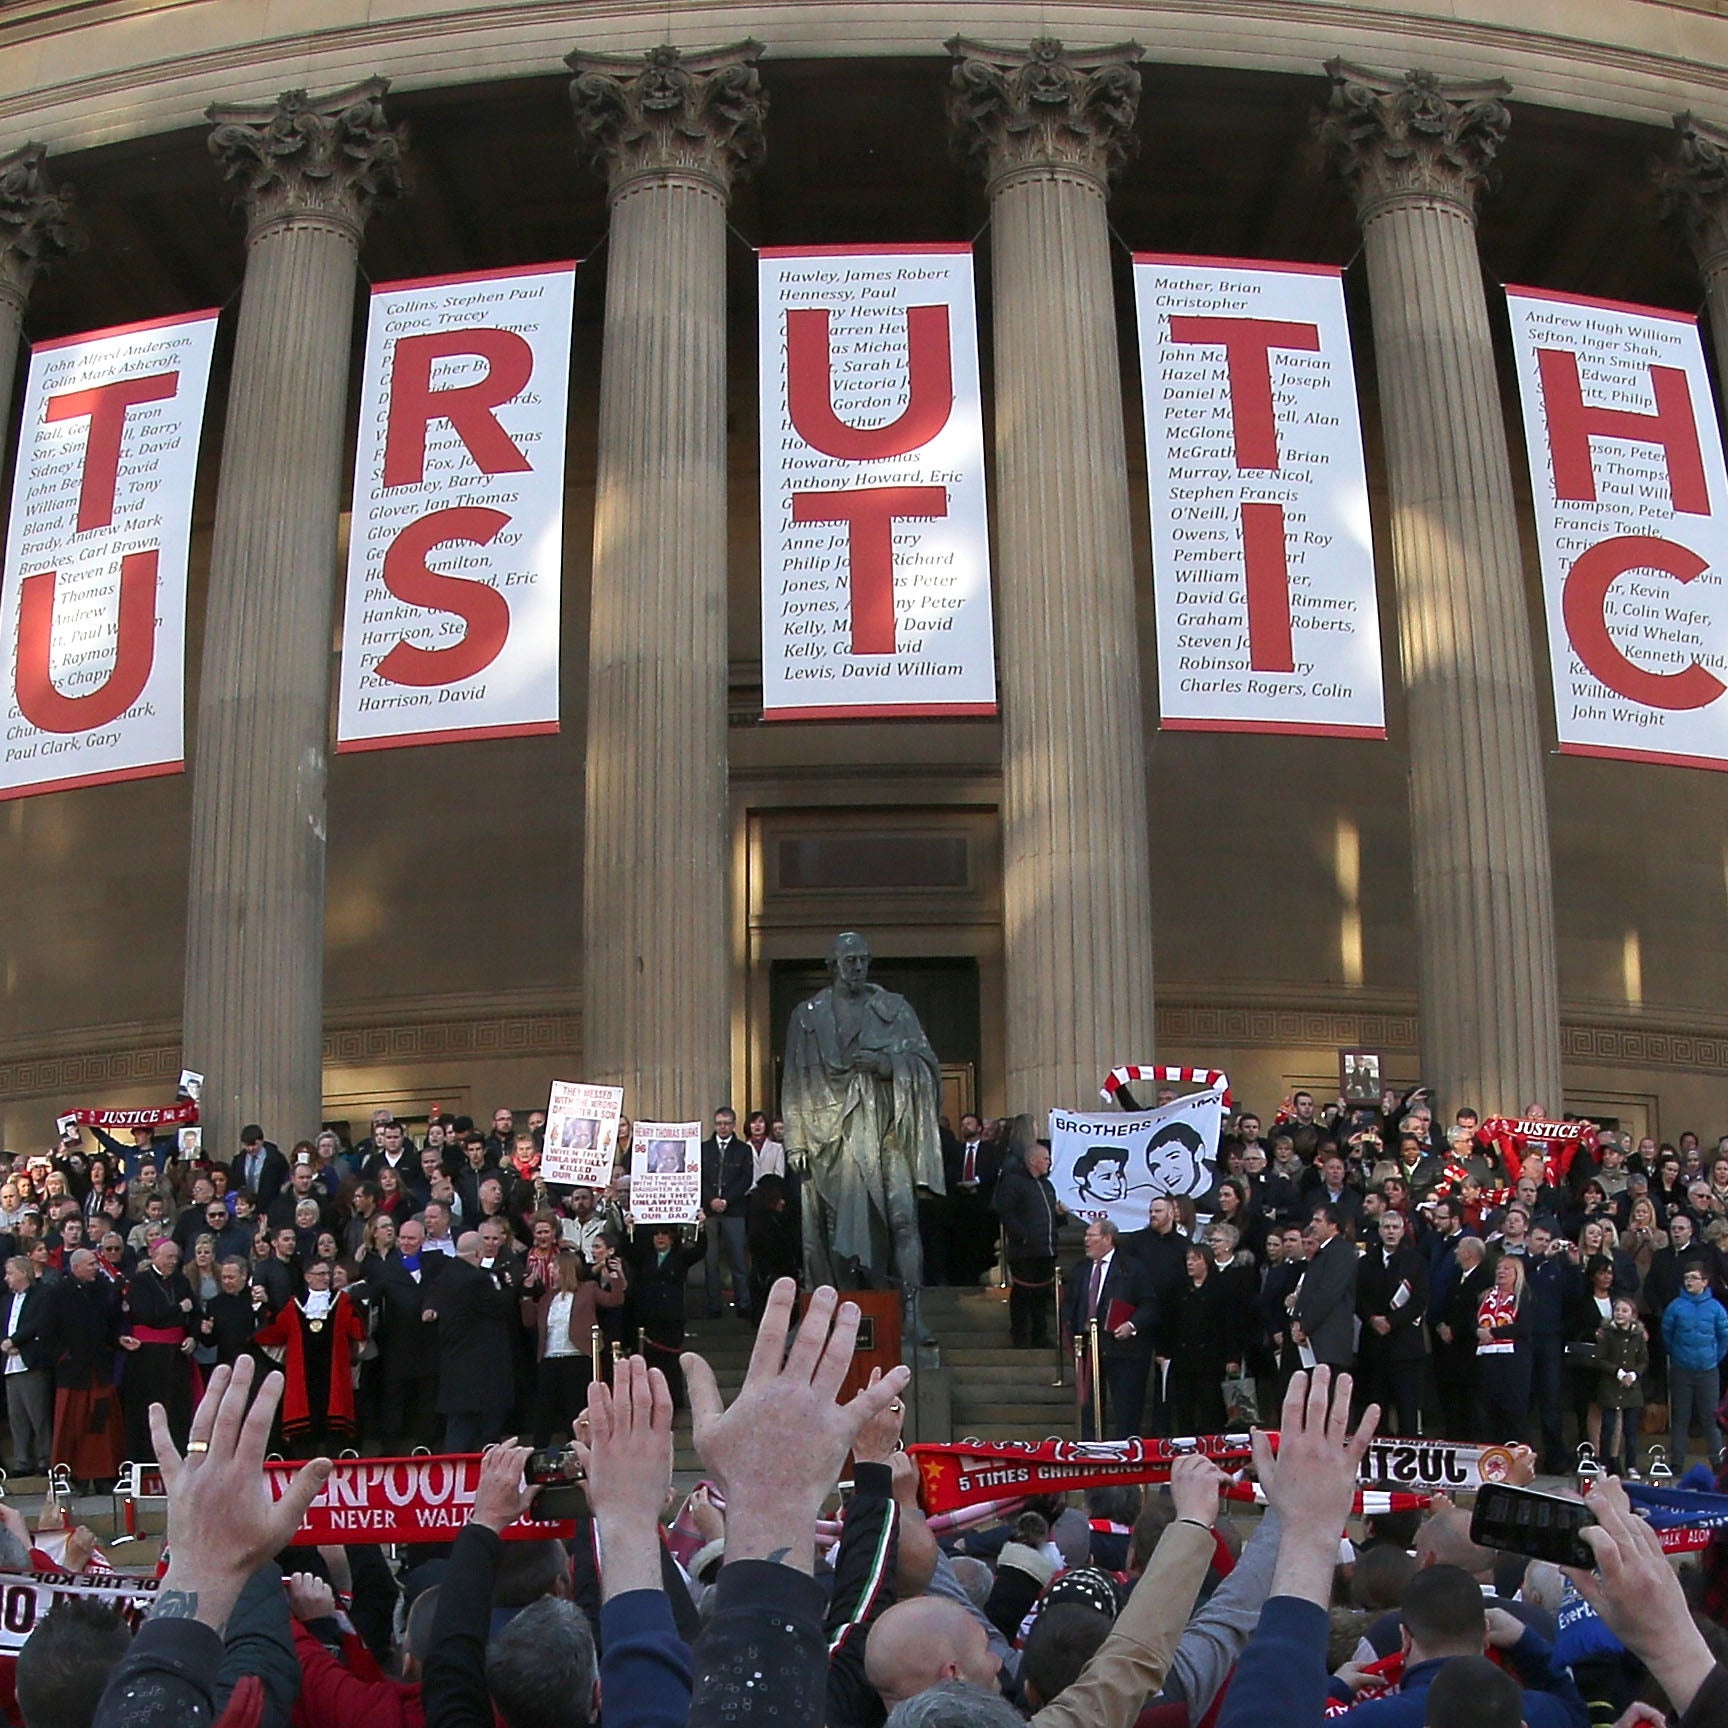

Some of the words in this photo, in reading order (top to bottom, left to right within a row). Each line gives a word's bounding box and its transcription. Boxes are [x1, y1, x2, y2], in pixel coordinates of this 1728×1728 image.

[779, 270, 840, 284] Hawley,
[844, 269, 891, 282] James
[897, 268, 951, 280] Robert
[861, 287, 897, 299] Paul
[1154, 278, 1213, 292] Mather,
[1219, 282, 1262, 293] Brian
[387, 300, 438, 315] Collins,
[443, 292, 503, 309] Stephen
[509, 286, 544, 300] Paul
[1156, 295, 1248, 310] Christopher
[439, 310, 489, 325] Tracey
[1525, 312, 1581, 327] Andrew
[1585, 319, 1623, 335] Hugh
[1628, 326, 1682, 345] William
[44, 360, 74, 375] John
[843, 360, 890, 373] Sarah
[1159, 350, 1195, 364] John
[1275, 353, 1331, 370] Marian
[42, 373, 75, 390] Colin
[834, 377, 896, 390] Victoria
[1162, 368, 1206, 381] Hazel
[1280, 373, 1331, 390] Joseph
[1582, 369, 1637, 387] Edward
[1163, 388, 1214, 400] Daniel
[834, 397, 891, 410] Gordon
[1164, 407, 1206, 419] Peter
[1304, 413, 1340, 426] Alan
[140, 422, 181, 439] Barry
[139, 437, 181, 455] David
[29, 462, 74, 480] Sidney
[931, 470, 963, 483] Eric
[27, 484, 56, 500] John
[128, 479, 162, 495] Tony
[1602, 481, 1634, 495] Paul
[369, 504, 418, 520] Glover,
[455, 491, 519, 507] Thomas
[124, 515, 163, 532] Mark
[1554, 517, 1609, 533] Francis
[79, 544, 107, 561] Carl
[505, 572, 538, 586] Eric
[1630, 583, 1670, 600] Kevin
[363, 608, 422, 624] Hankin,
[1623, 602, 1659, 619] Colin
[362, 628, 433, 645] Harrison,
[842, 663, 891, 677] David
[898, 662, 963, 676] William
[359, 693, 433, 712] Harrison,
[439, 685, 486, 702] David
[1572, 705, 1606, 720] John
[1612, 708, 1665, 727] Wright
[6, 744, 36, 762] Paul
[86, 732, 121, 748] Gary
[100, 1109, 160, 1126] JUSTICE
[1056, 1118, 1151, 1136] BROTHERS
[1514, 1121, 1581, 1138] JUSTICE
[546, 1155, 609, 1166] UNLAWFULLY
[559, 1165, 592, 1173] KILLED
[552, 1171, 571, 1179] OUR
[958, 1476, 970, 1492] 5
[975, 1467, 1030, 1489] TIMES
[331, 1510, 397, 1529] NEVER
